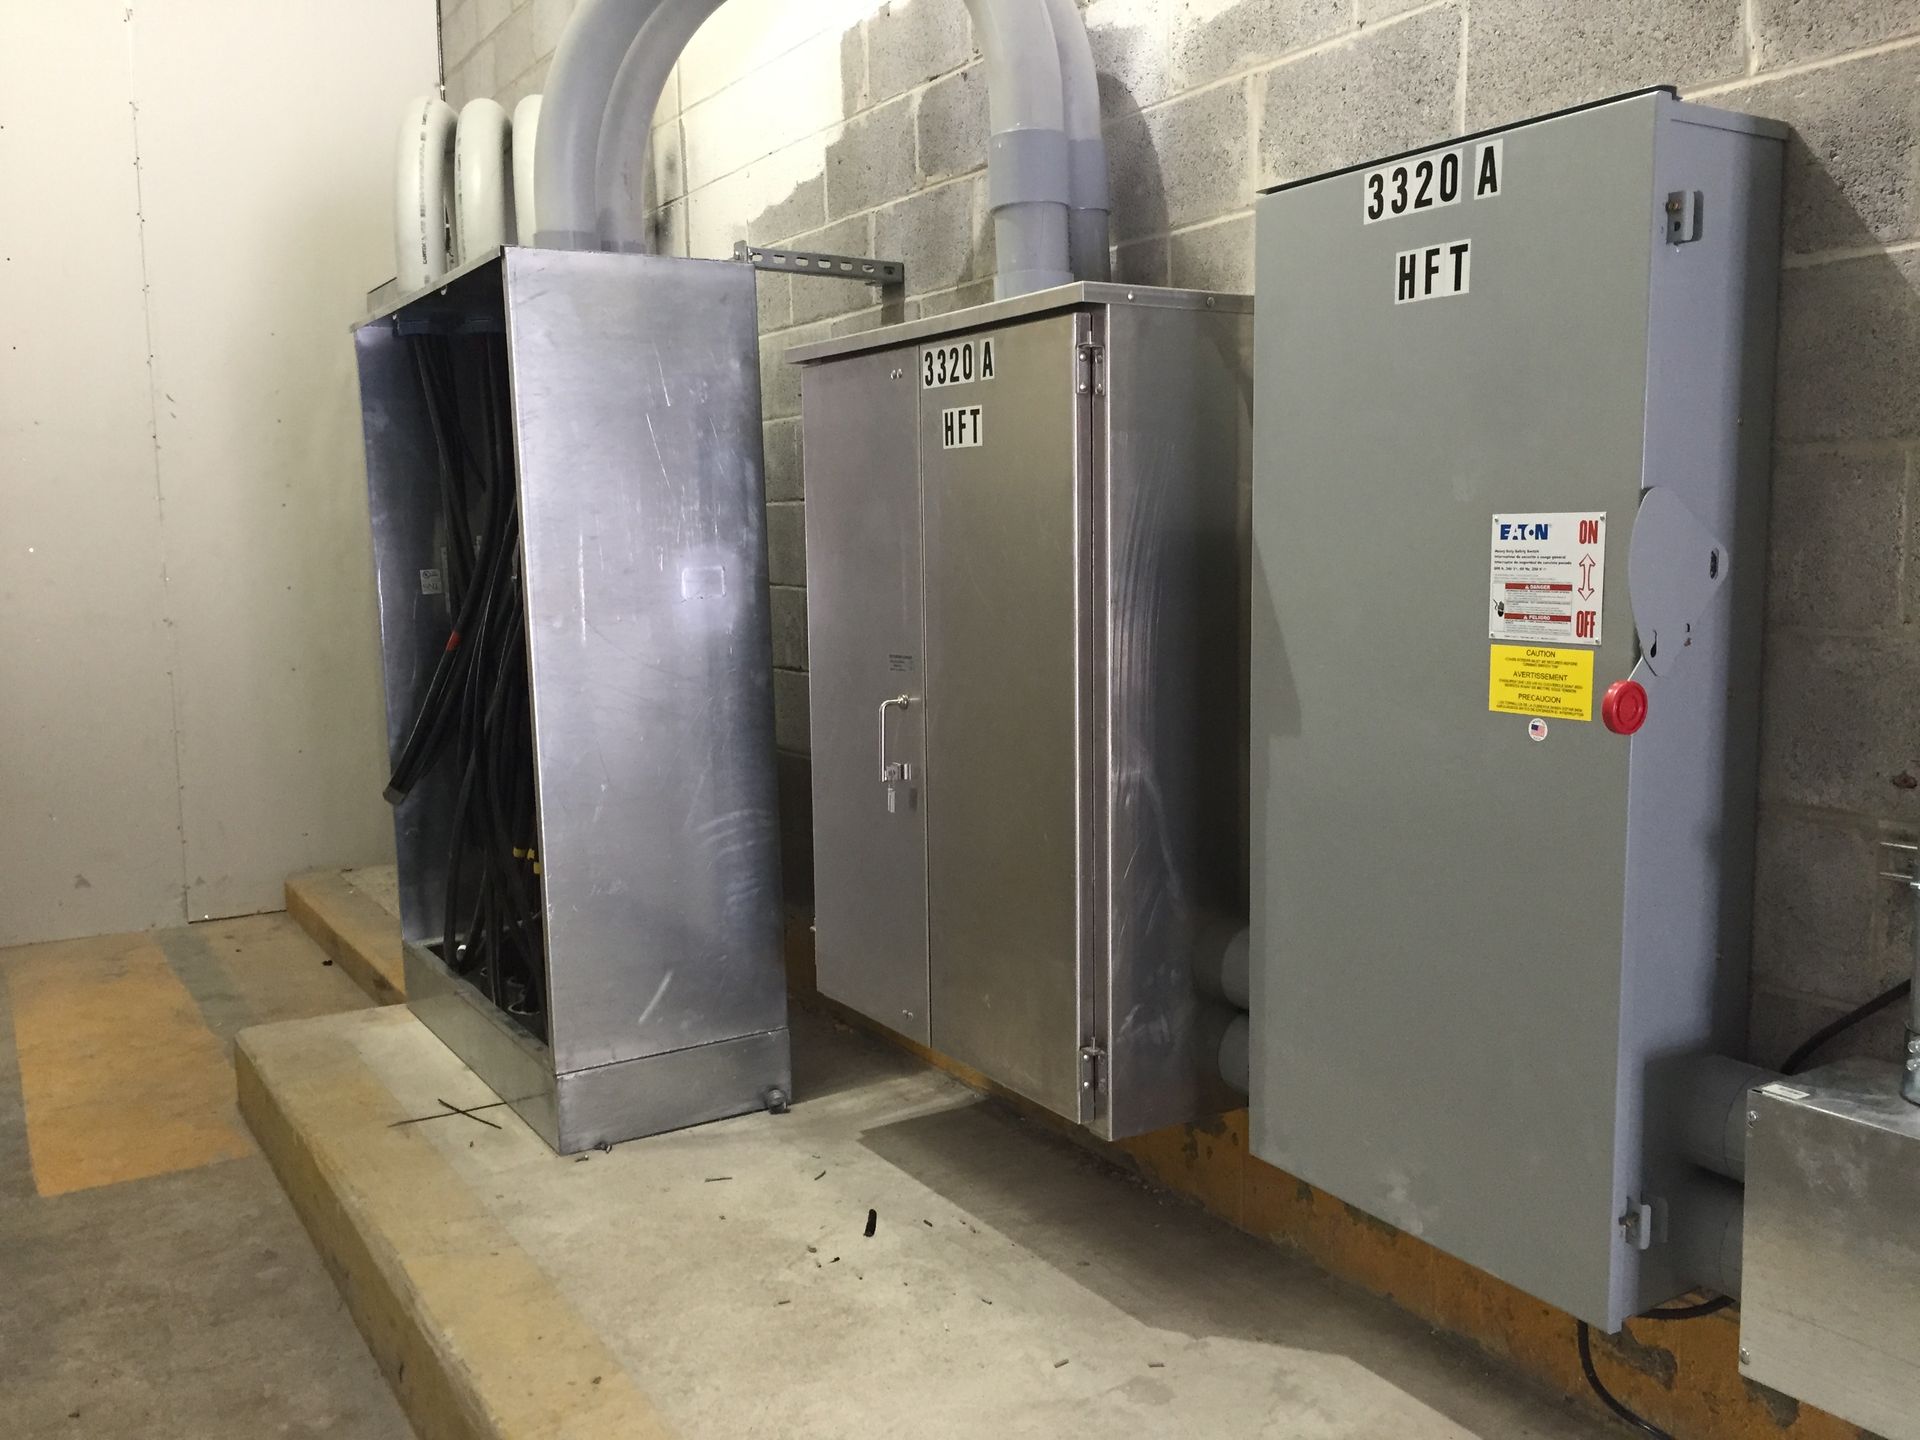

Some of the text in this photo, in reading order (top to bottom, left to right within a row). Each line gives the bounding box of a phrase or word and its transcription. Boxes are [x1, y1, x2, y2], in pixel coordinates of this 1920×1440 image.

[1368, 146, 1498, 220] 3320 A
[1398, 243, 1469, 301] HFT
[924, 341, 993, 387] 3320 A
[944, 408, 980, 446] HFT
[1500, 524, 1549, 541] EATON
[1579, 520, 1599, 544] ON
[1576, 610, 1597, 638] OFF
[1526, 649, 1556, 658] CAUTION
[1513, 671, 1568, 681] AVERTISSEMENT
[1518, 693, 1561, 704] PRECAUCION
